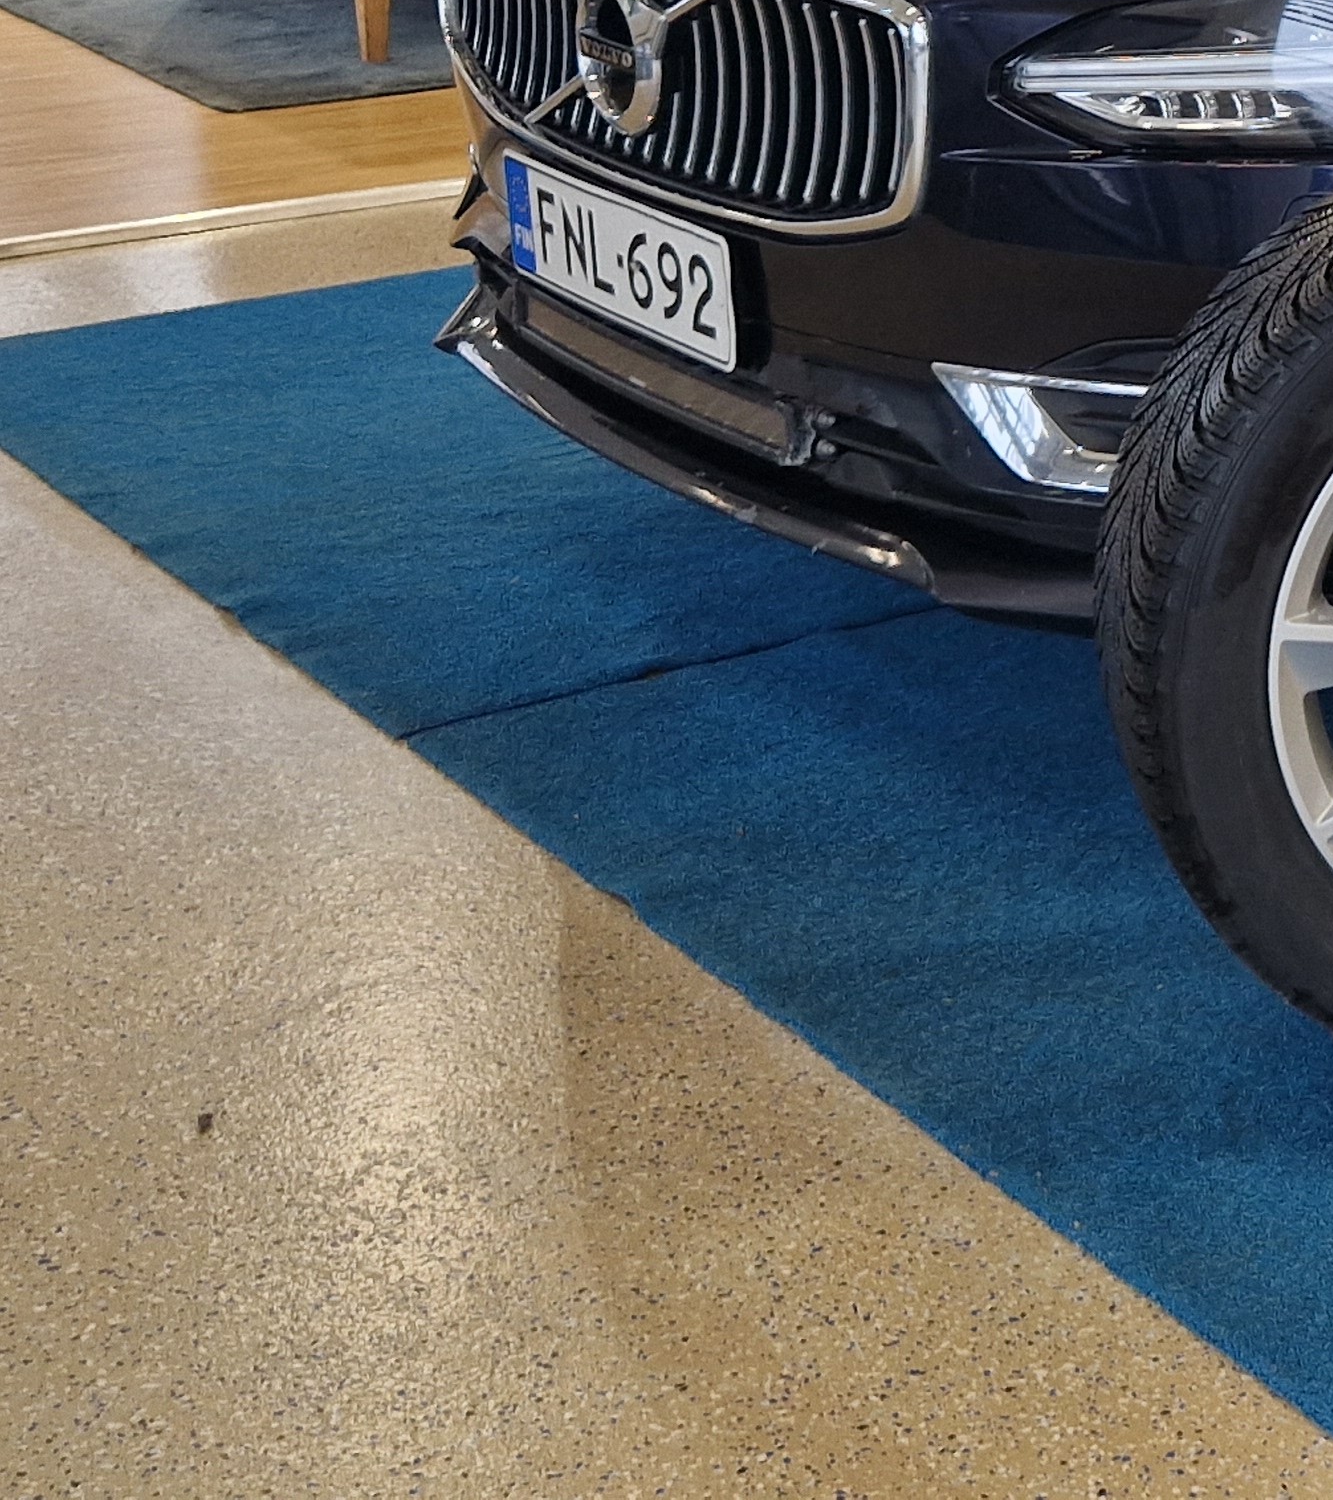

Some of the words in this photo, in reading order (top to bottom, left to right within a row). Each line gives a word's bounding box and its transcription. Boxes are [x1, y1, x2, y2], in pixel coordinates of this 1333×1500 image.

[580, 35, 633, 68] VOLVO
[514, 225, 535, 253] FIN
[536, 188, 717, 340] FNL-692
